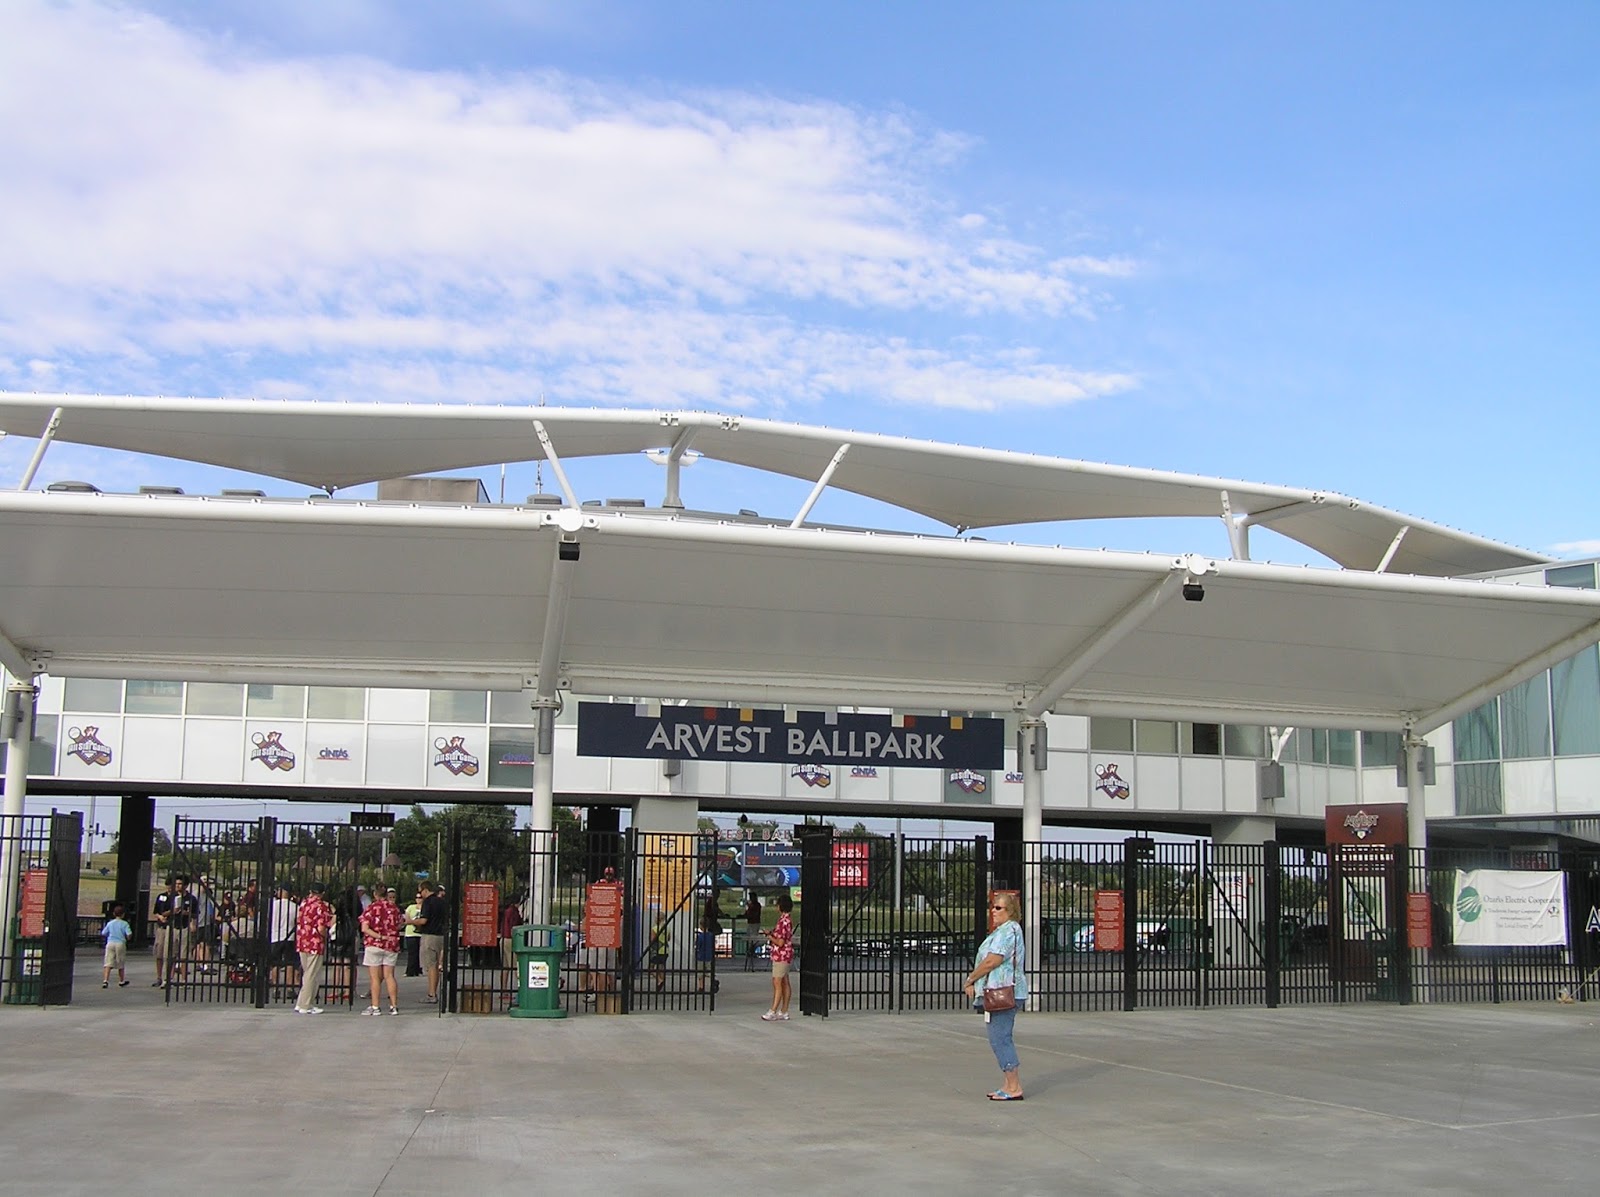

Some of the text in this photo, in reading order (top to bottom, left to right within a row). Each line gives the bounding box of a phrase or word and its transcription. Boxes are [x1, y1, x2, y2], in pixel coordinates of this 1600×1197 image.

[645, 721, 945, 761] ARVEST BALLPARK
[1483, 895, 1503, 903] Ozarks
[1505, 896, 1527, 904] Electric
